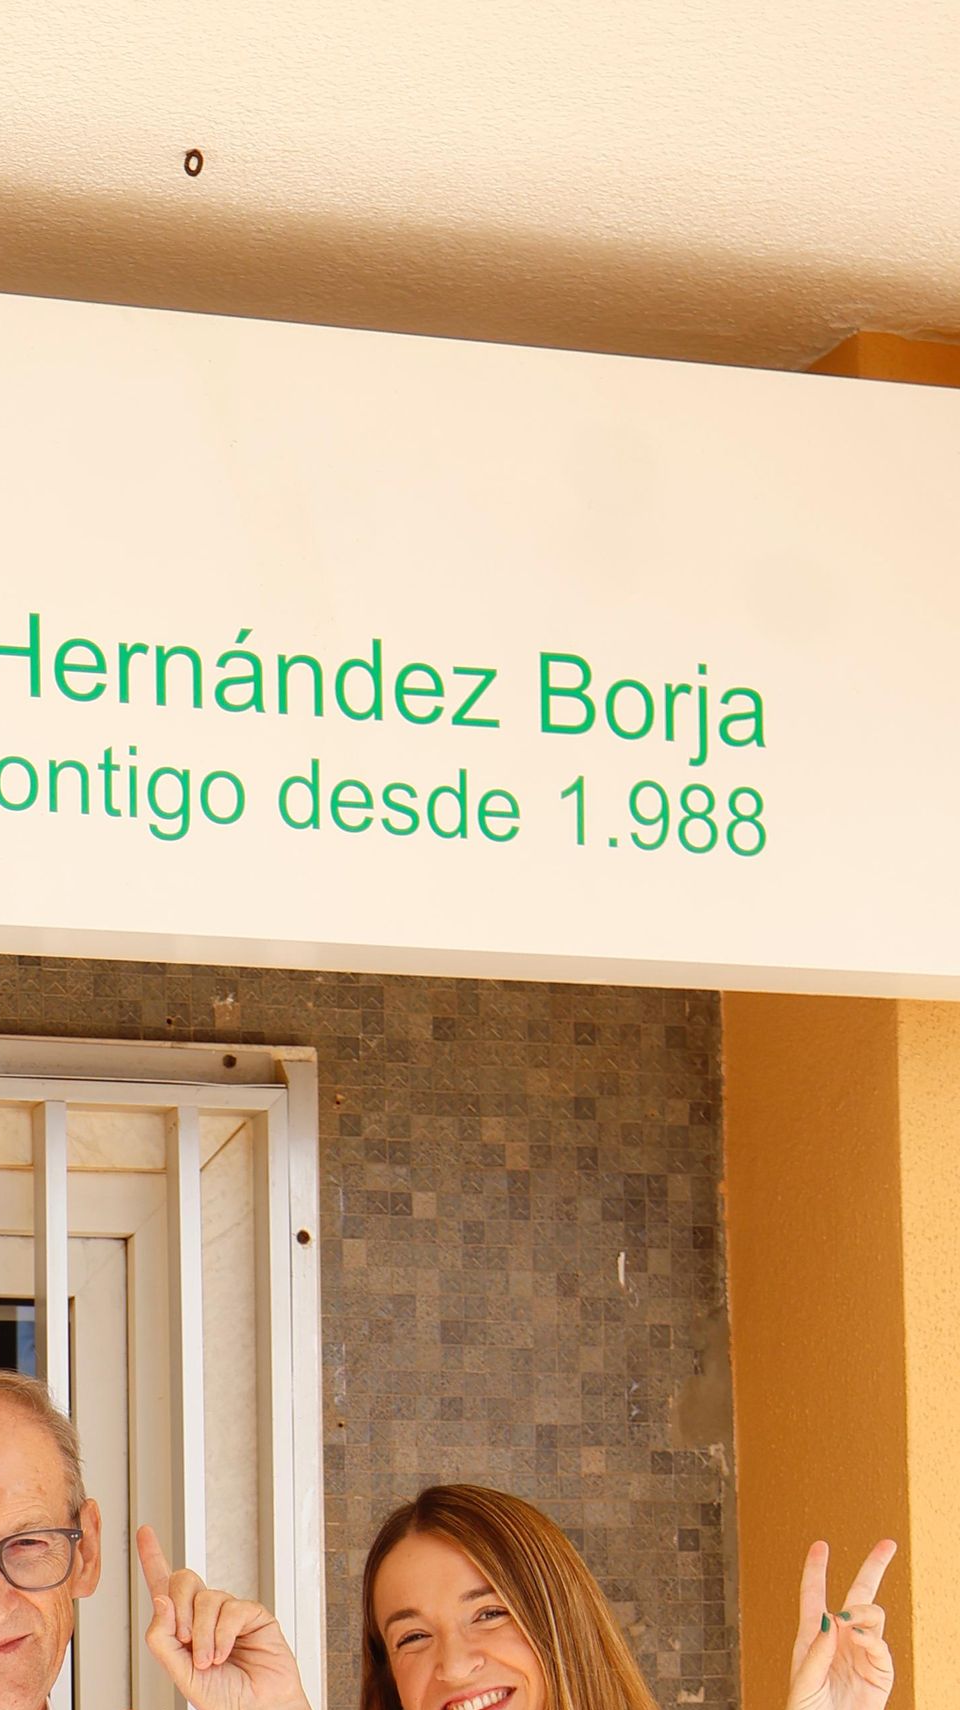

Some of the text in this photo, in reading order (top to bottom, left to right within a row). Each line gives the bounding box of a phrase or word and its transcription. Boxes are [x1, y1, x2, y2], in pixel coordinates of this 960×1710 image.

[540, 653, 765, 768] Borja
[278, 759, 520, 843] desde
[561, 777, 766, 857] 1.988
